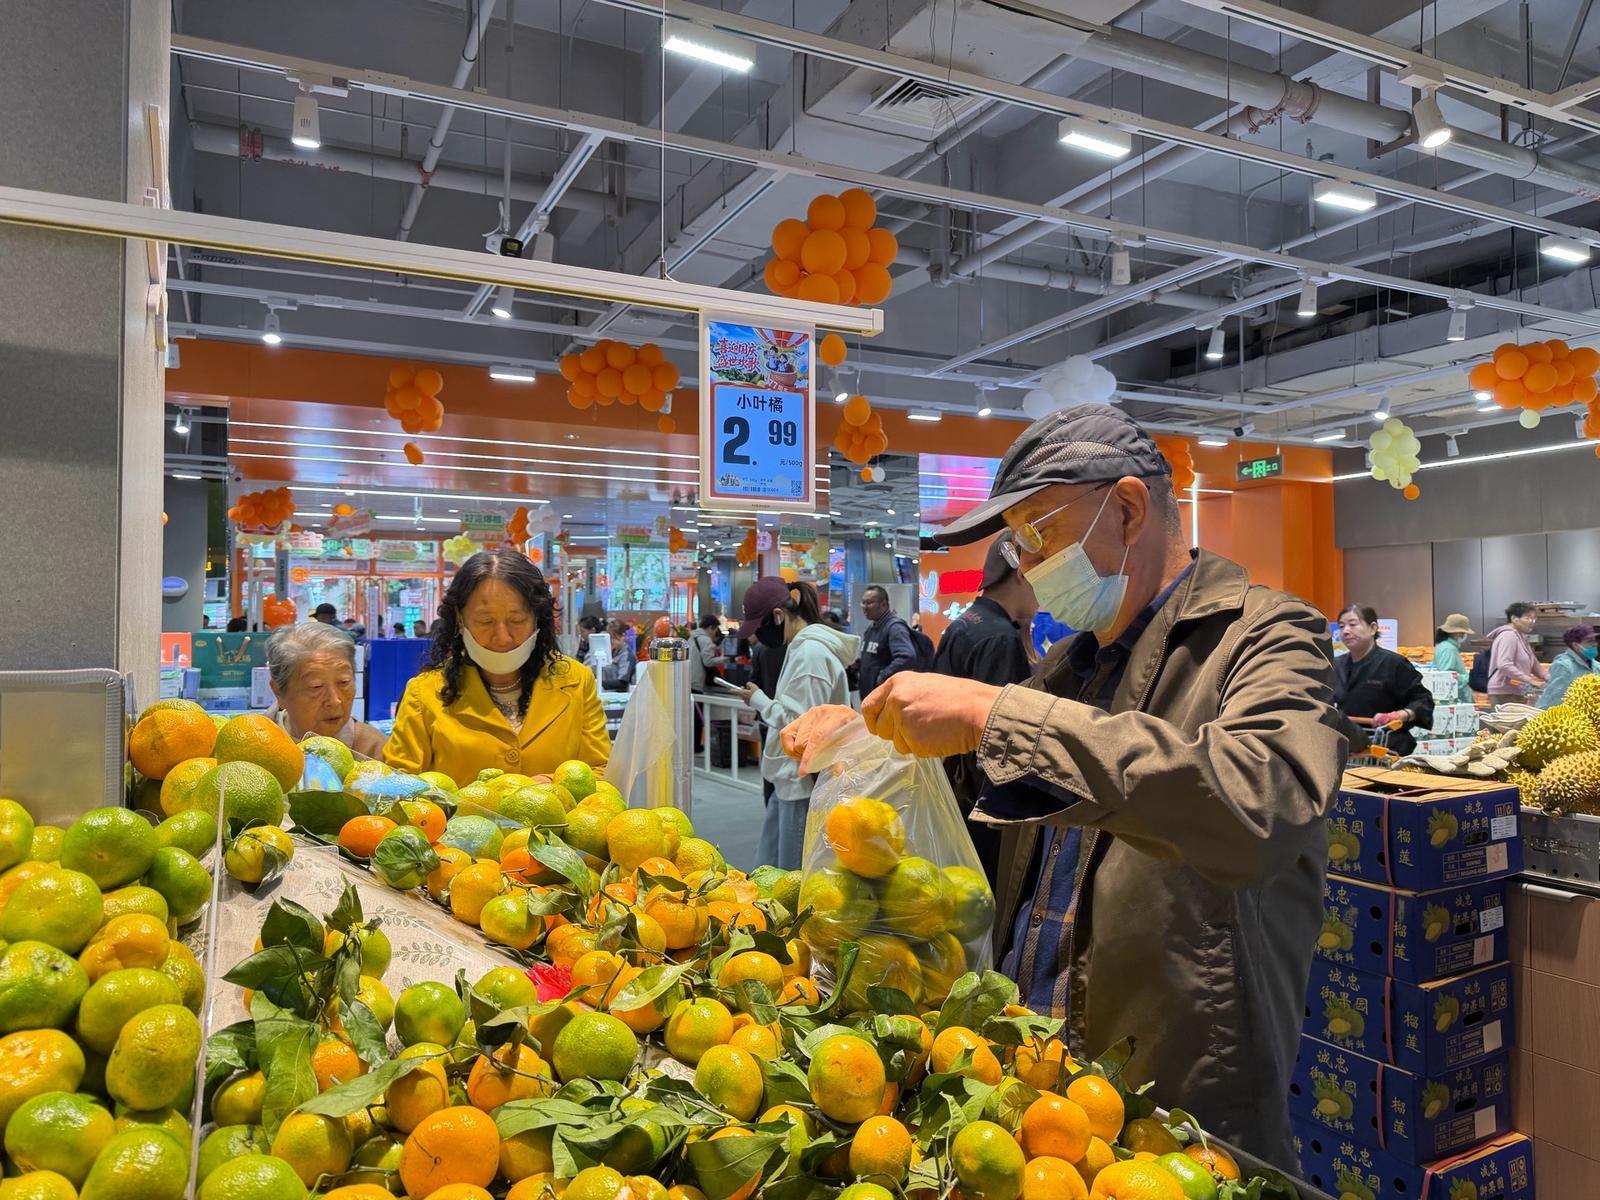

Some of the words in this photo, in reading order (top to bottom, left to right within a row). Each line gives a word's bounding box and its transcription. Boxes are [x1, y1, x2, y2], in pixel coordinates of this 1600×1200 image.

[717, 338, 758, 357] 喜迎国庆
[714, 356, 760, 372] 盛世欢歌
[737, 394, 783, 413] 小叶橘
[768, 420, 797, 447] 99
[779, 459, 803, 468] 元/500g
[1397, 826, 1414, 867] 榴莲
[1393, 921, 1409, 962] 榴莲
[1403, 1011, 1421, 1053] 榴莲
[1391, 1096, 1408, 1139] 榴莲
